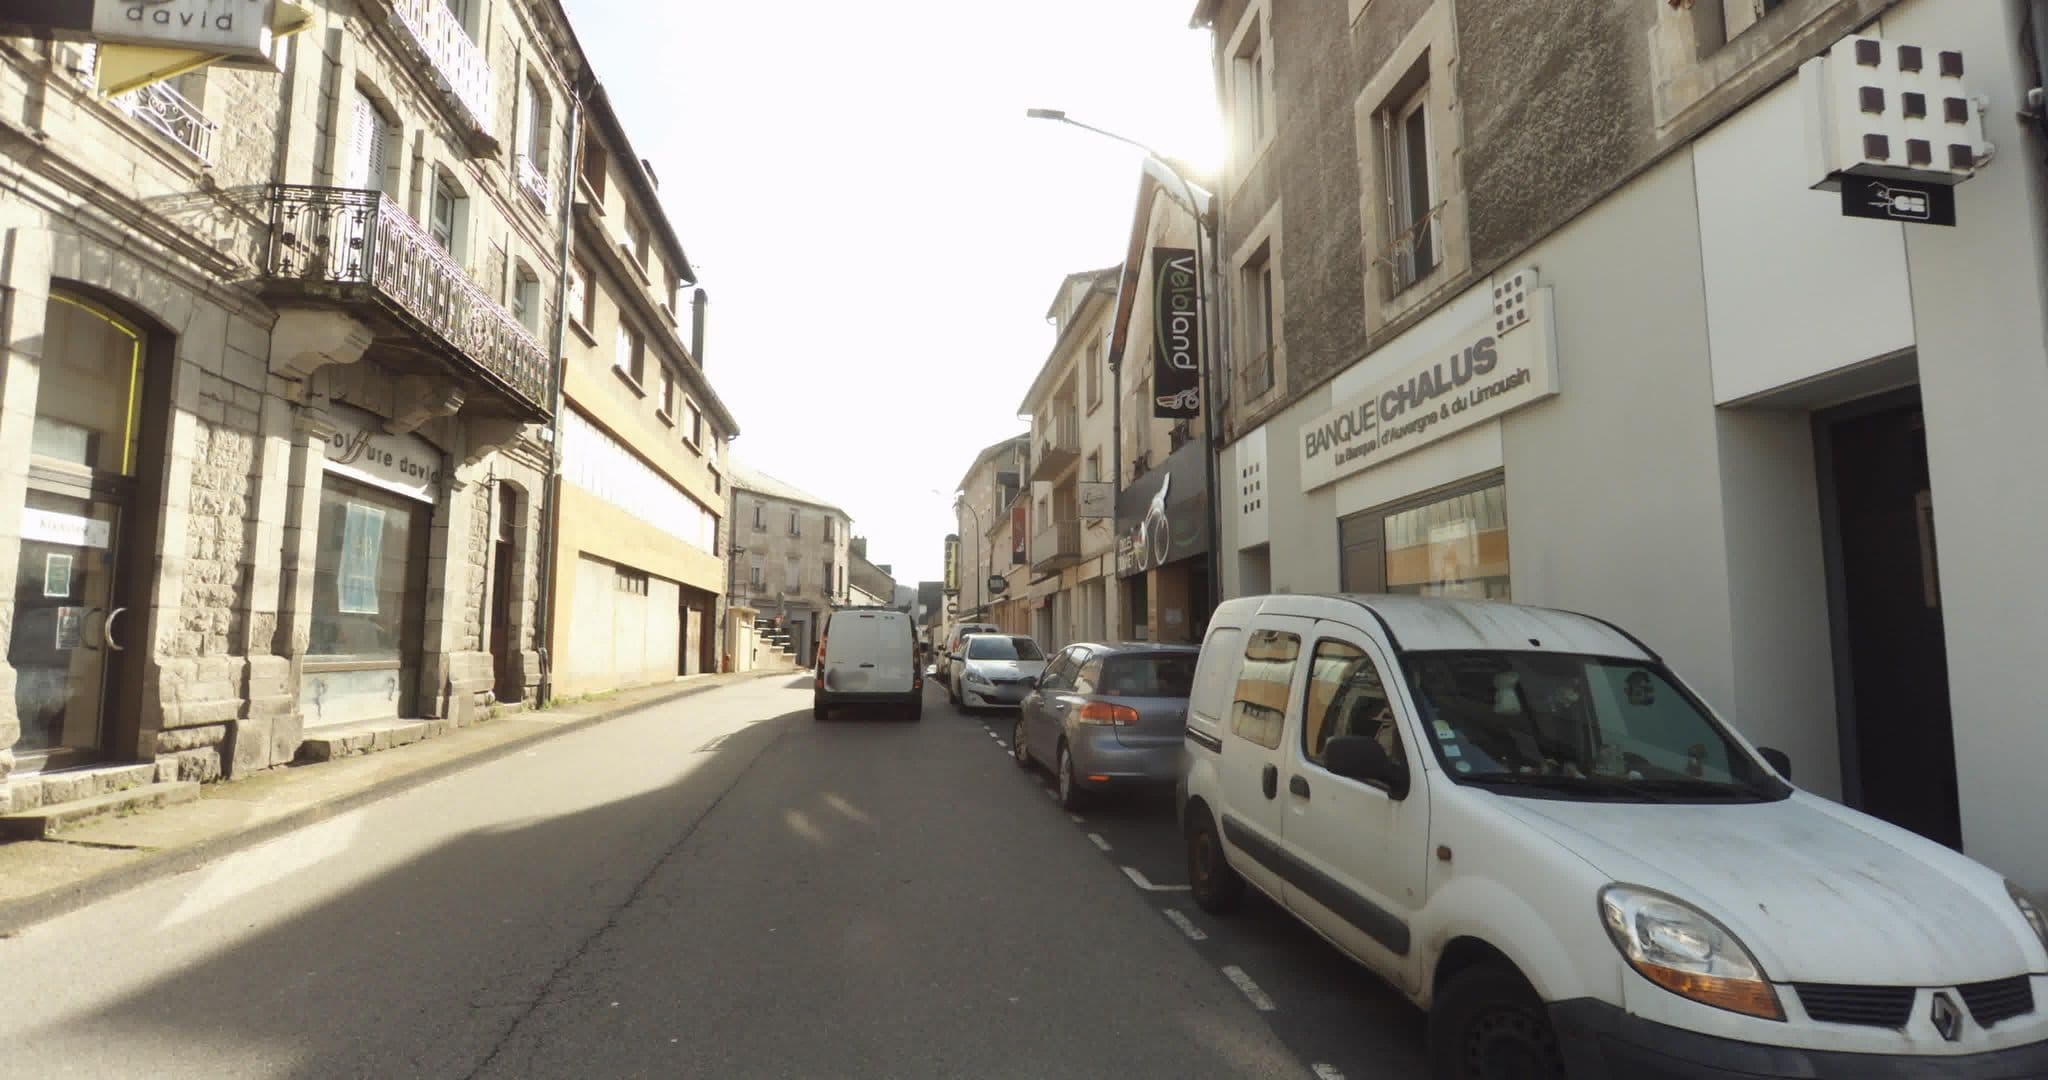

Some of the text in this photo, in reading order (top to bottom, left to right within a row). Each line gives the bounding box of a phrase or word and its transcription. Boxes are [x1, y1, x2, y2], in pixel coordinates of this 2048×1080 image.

[126, 5, 233, 31] david
[1170, 256, 1198, 370] Veloland
[1305, 336, 1498, 460] BANQUE CHALUS
[1345, 439, 1377, 461] Banque
[1381, 411, 1438, 446] d'Auvergne
[1440, 403, 1451, 420] &
[1452, 396, 1468, 415] du
[1470, 367, 1531, 407] Limousin
[324, 430, 393, 467] oiffure
